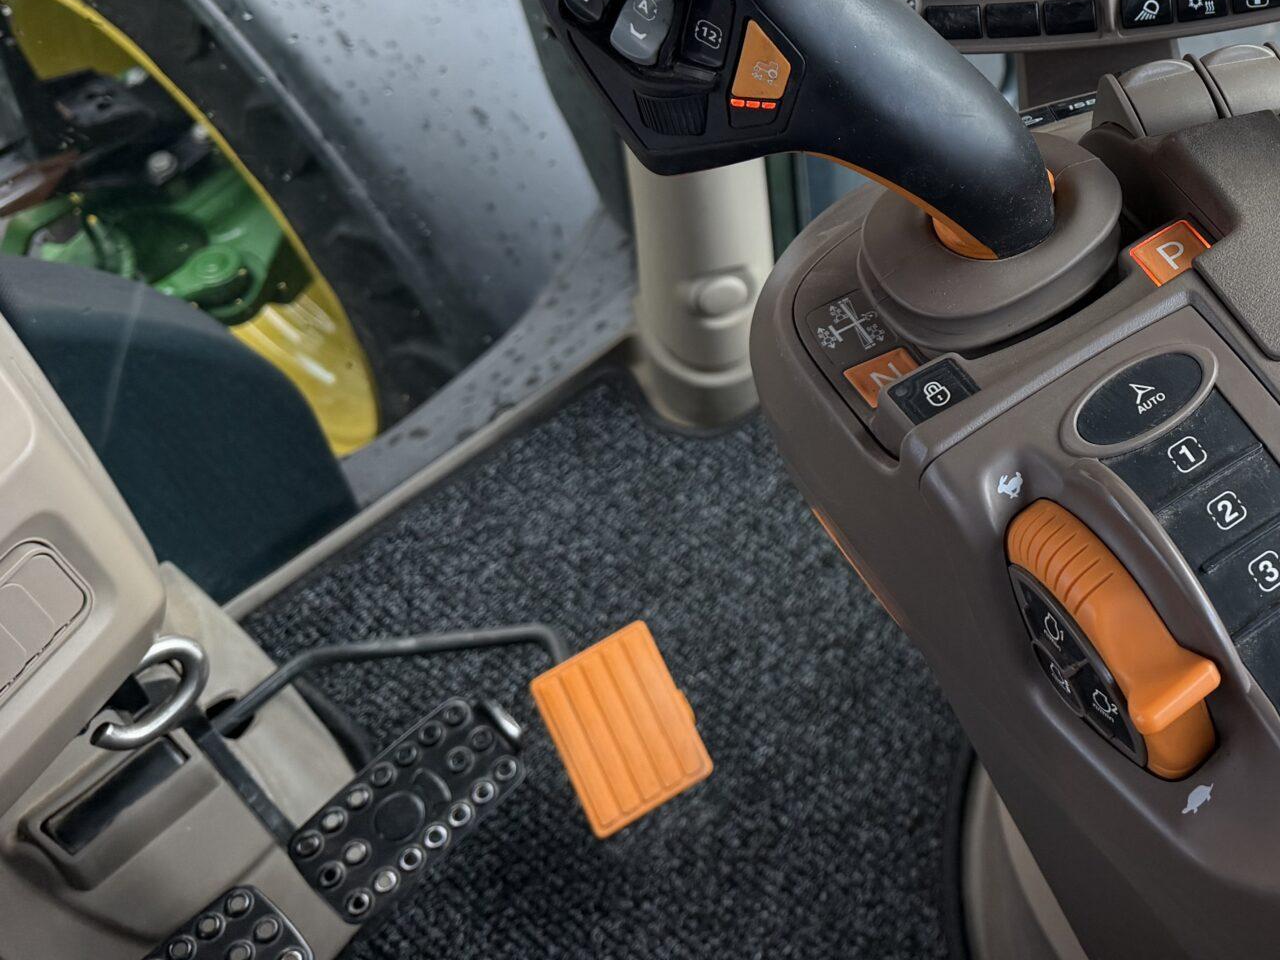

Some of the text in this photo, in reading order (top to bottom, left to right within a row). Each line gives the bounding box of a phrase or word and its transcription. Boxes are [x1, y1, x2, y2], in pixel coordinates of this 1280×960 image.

[638, 0, 649, 12] A
[700, 27, 717, 42] 12
[1156, 240, 1185, 270] P
[1137, 390, 1167, 415] AUTO
[1179, 446, 1196, 464] 1
[1218, 499, 1239, 523] 2
[1260, 561, 1280, 583] 3
